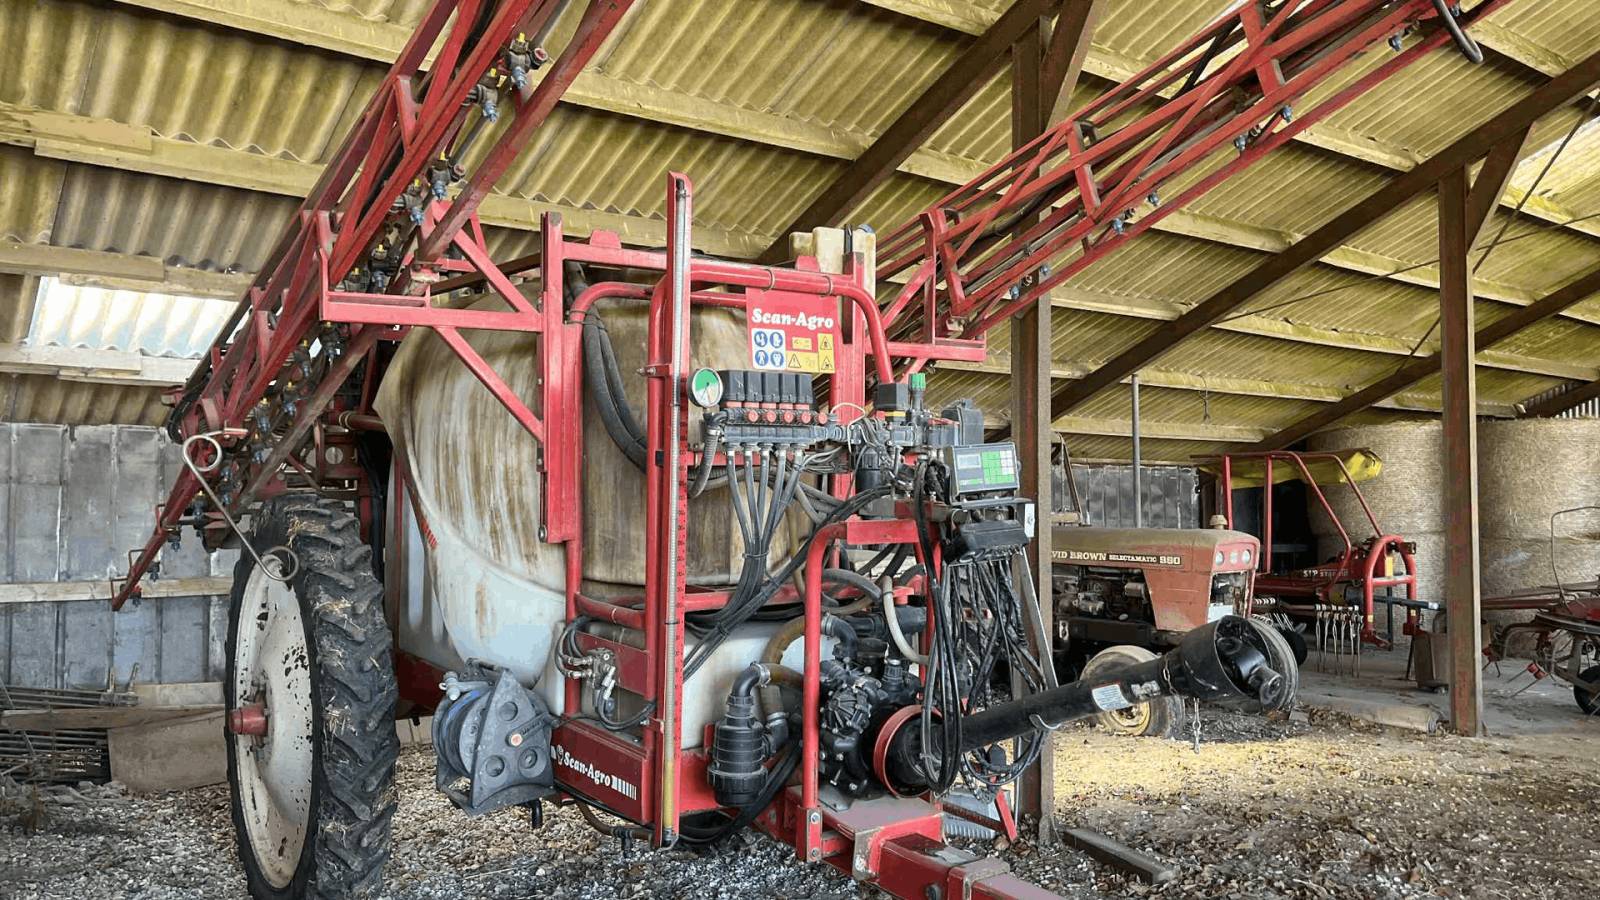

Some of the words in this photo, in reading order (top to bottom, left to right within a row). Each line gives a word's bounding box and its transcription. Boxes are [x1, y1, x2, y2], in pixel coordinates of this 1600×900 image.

[751, 308, 834, 330] Scan-Agro
[1070, 551, 1106, 561] BROWN
[564, 752, 611, 786] Scan-Agro
